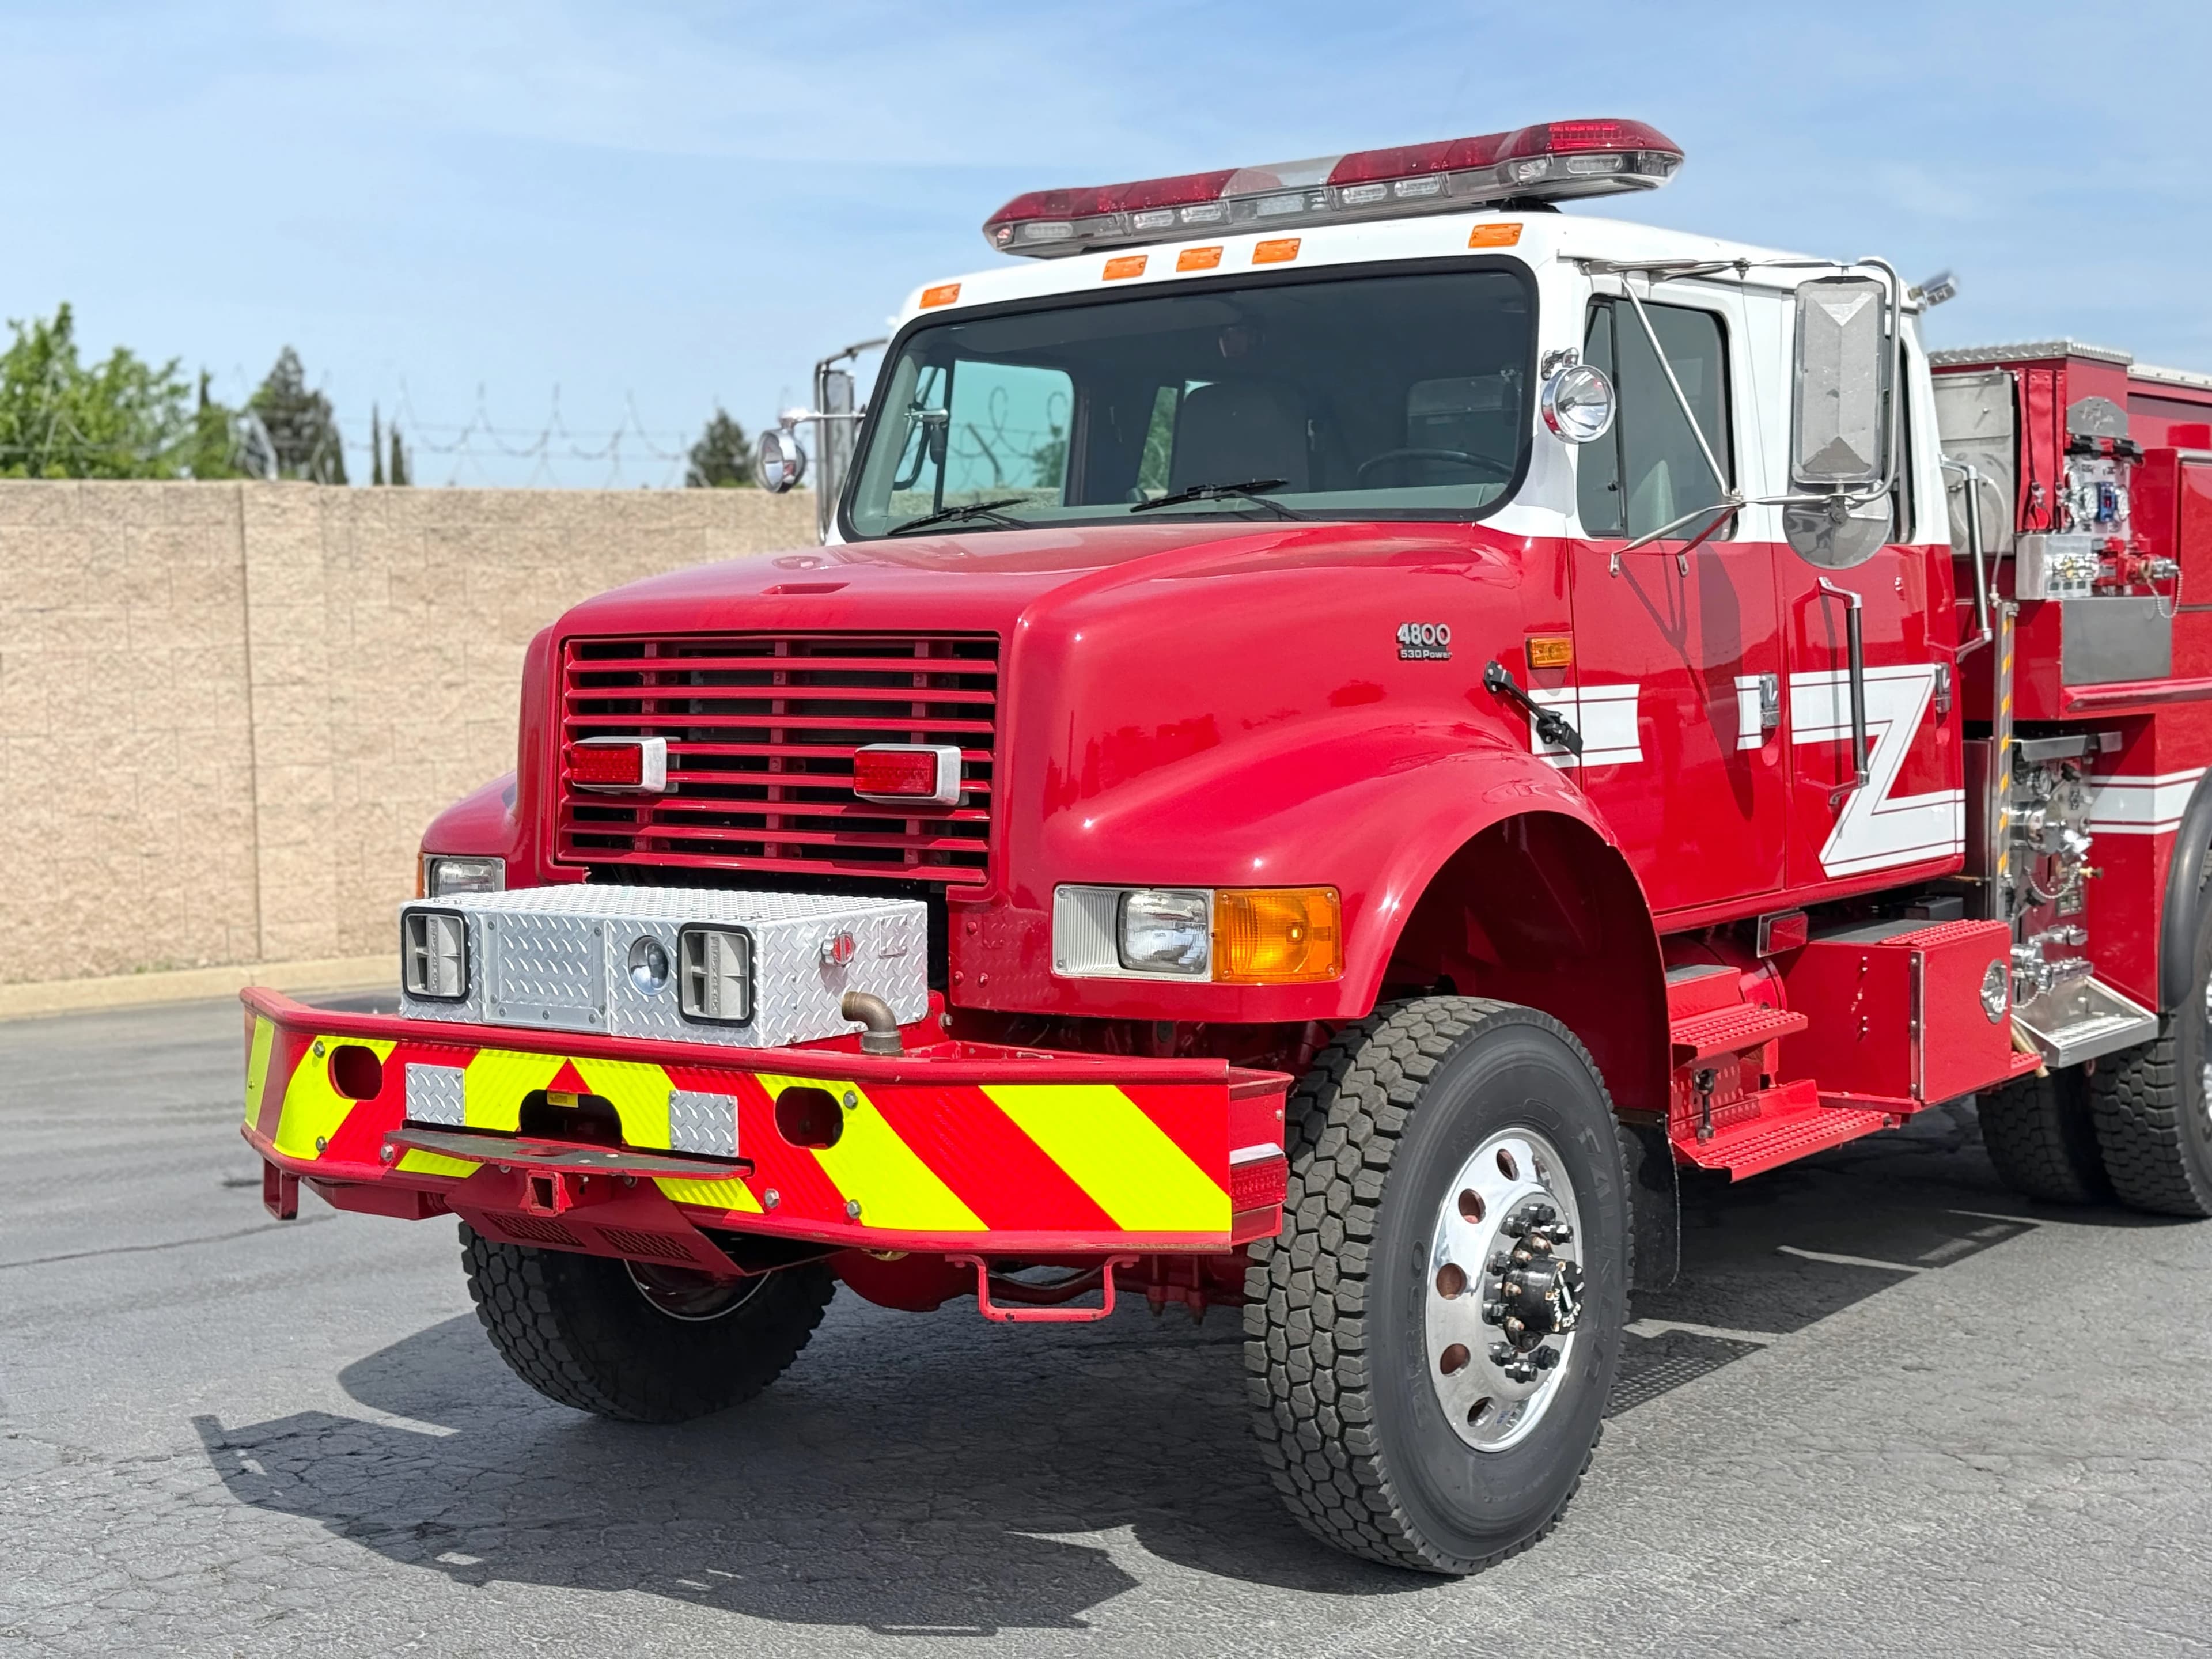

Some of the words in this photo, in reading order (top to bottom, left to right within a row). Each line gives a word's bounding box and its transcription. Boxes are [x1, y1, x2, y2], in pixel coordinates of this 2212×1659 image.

[1396, 623, 1451, 645] 4800
[1400, 649, 1422, 658] 530
[1422, 649, 1453, 659] Power
[1579, 1126, 1618, 1389] FALKEN
